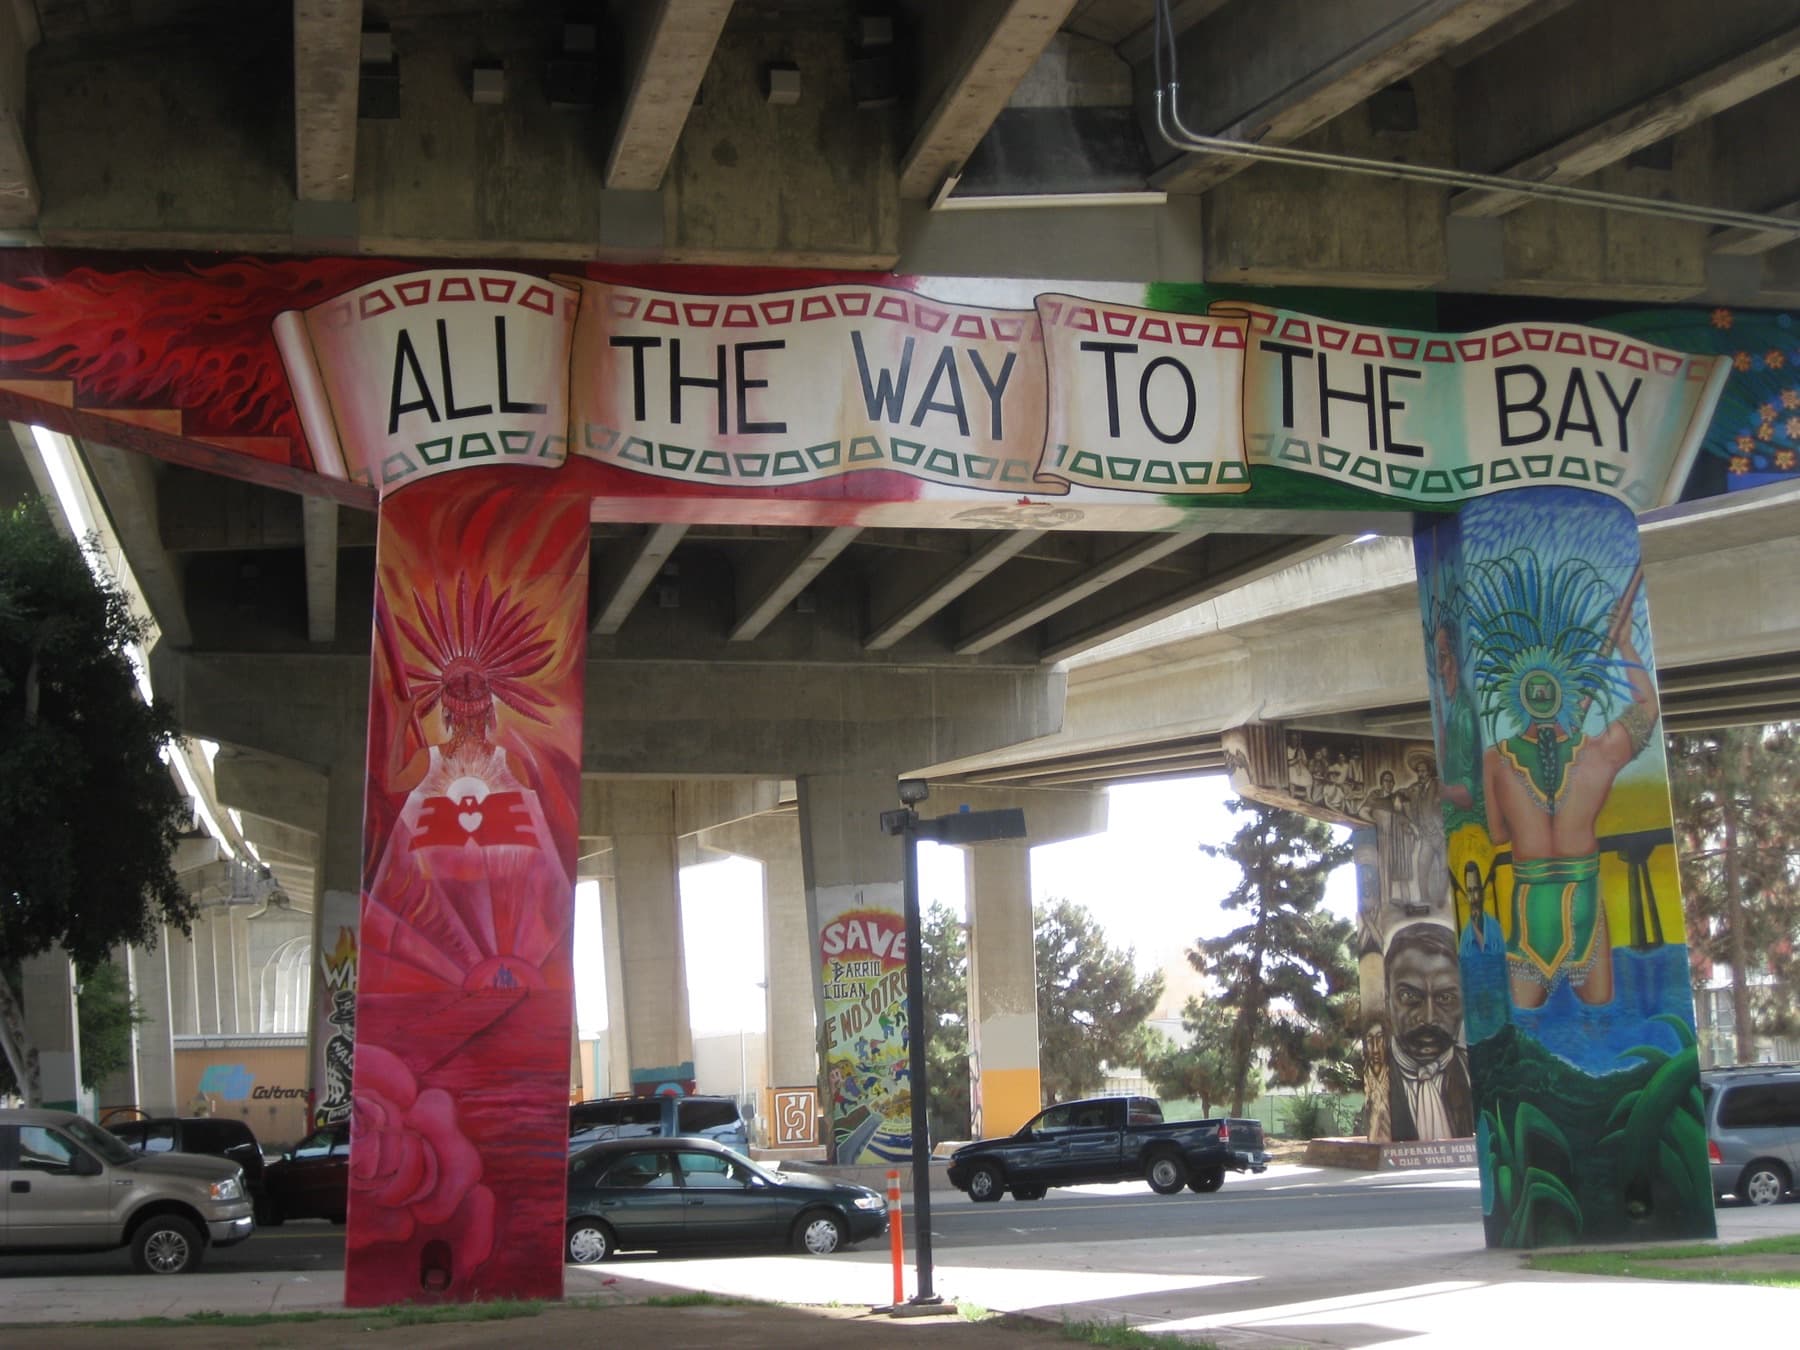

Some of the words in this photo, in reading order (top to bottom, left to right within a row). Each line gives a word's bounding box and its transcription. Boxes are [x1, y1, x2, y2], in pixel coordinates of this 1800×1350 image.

[387, 315, 547, 435] ALL
[609, 335, 786, 435] THE
[850, 330, 1017, 440] WAY
[1080, 341, 1197, 445] TO
[1260, 340, 1425, 457] THE
[1495, 364, 1643, 453] BAY
[823, 919, 906, 959] SAVE
[829, 959, 881, 982] BARRIO
[823, 981, 866, 1000] LOGAN
[252, 1085, 308, 1100] Caltran
